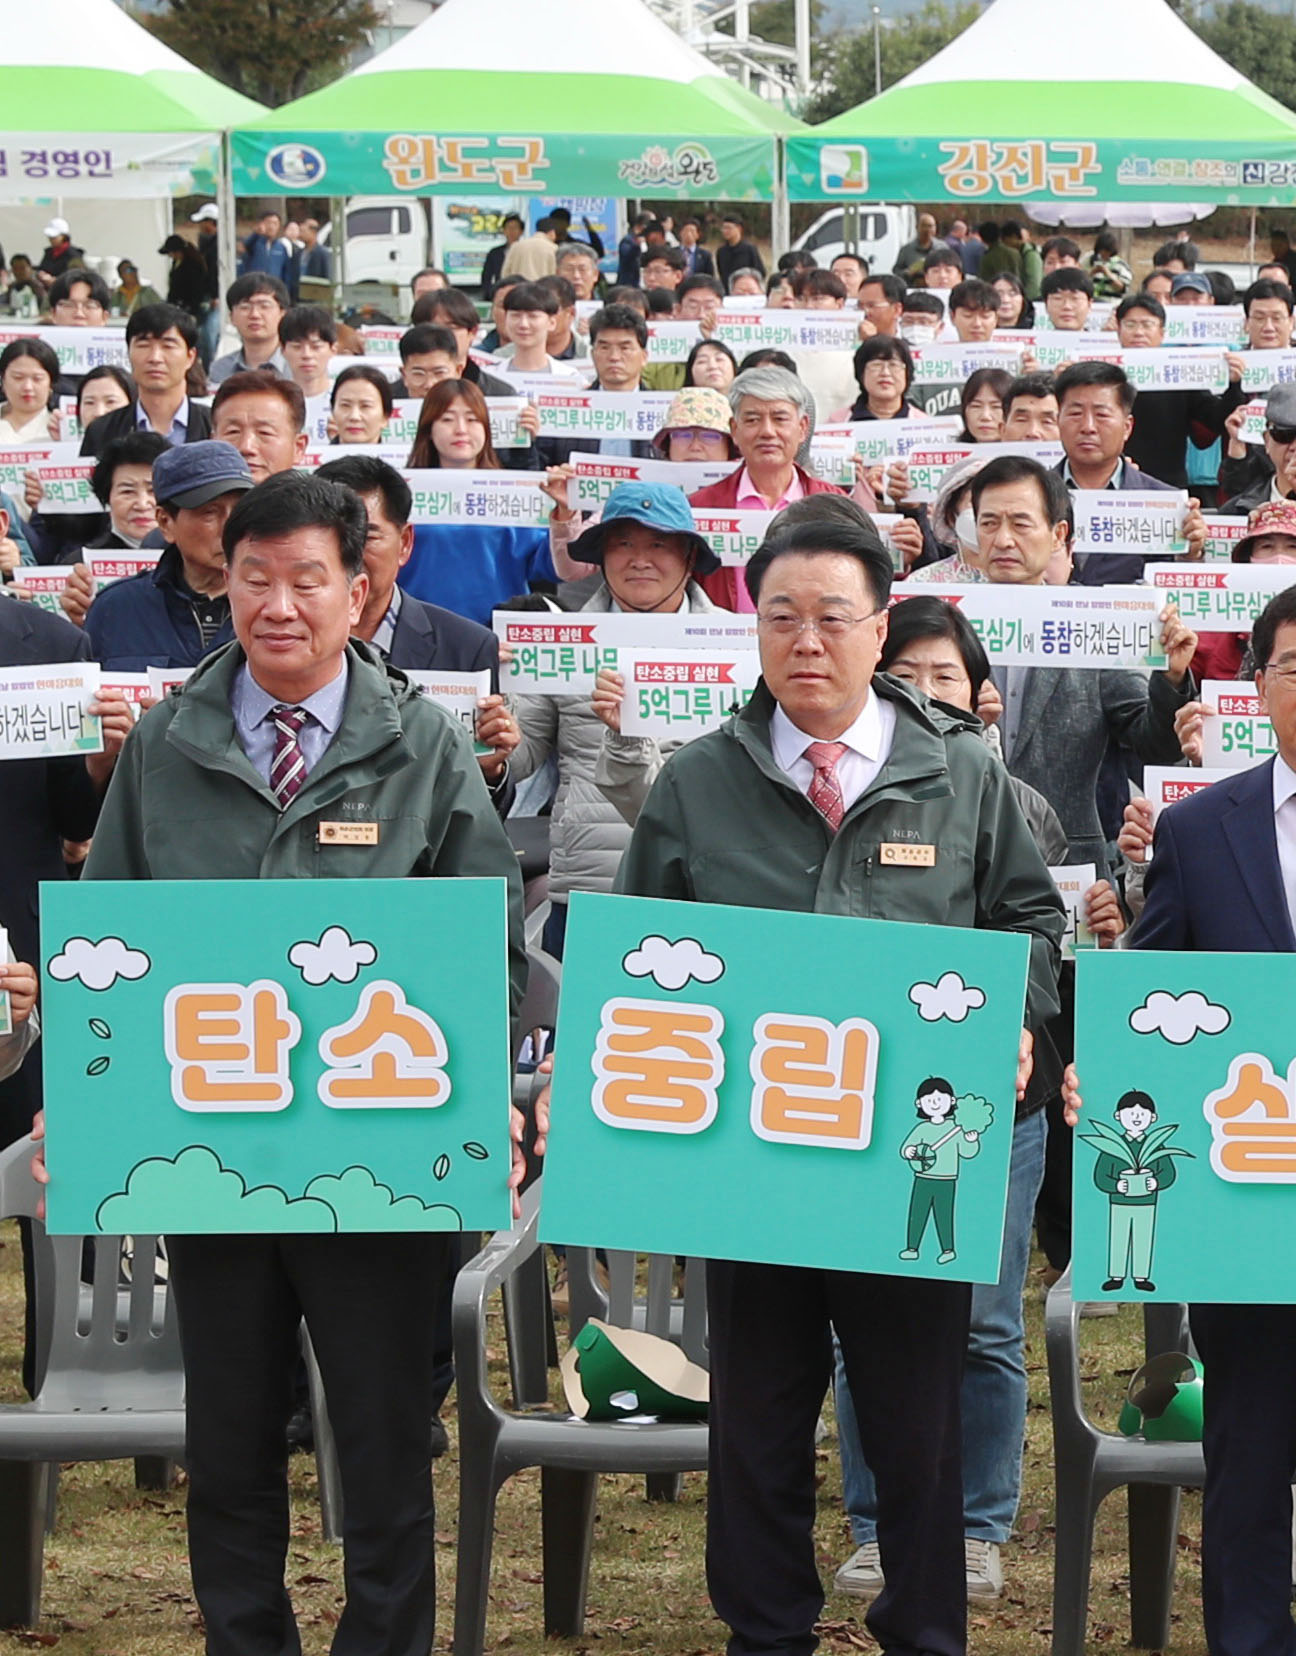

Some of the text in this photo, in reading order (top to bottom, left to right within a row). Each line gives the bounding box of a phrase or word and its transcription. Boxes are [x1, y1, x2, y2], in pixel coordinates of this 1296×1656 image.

[20, 149, 113, 179] 경영인
[383, 134, 551, 192] 완도군
[938, 140, 1101, 197] 강진군
[413, 490, 545, 518] 무심기에 동참하겠습니다
[1090, 516, 1178, 545] 동참하겠습니다
[1166, 590, 1211, 620] 억그루
[507, 626, 583, 641] 탄소중립 실현
[968, 619, 1154, 658] 무심기에 동참하겠습니다
[510, 646, 576, 682] 5억그루
[635, 665, 720, 681] 탄소중립 실현
[0, 703, 84, 743] 하겠습니다
[639, 687, 713, 725] 5억그루
[1219, 697, 1262, 715] 탄소중
[1222, 718, 1278, 757] 5억그
[163, 979, 451, 1113] 탄소
[591, 997, 880, 1152] 중립
